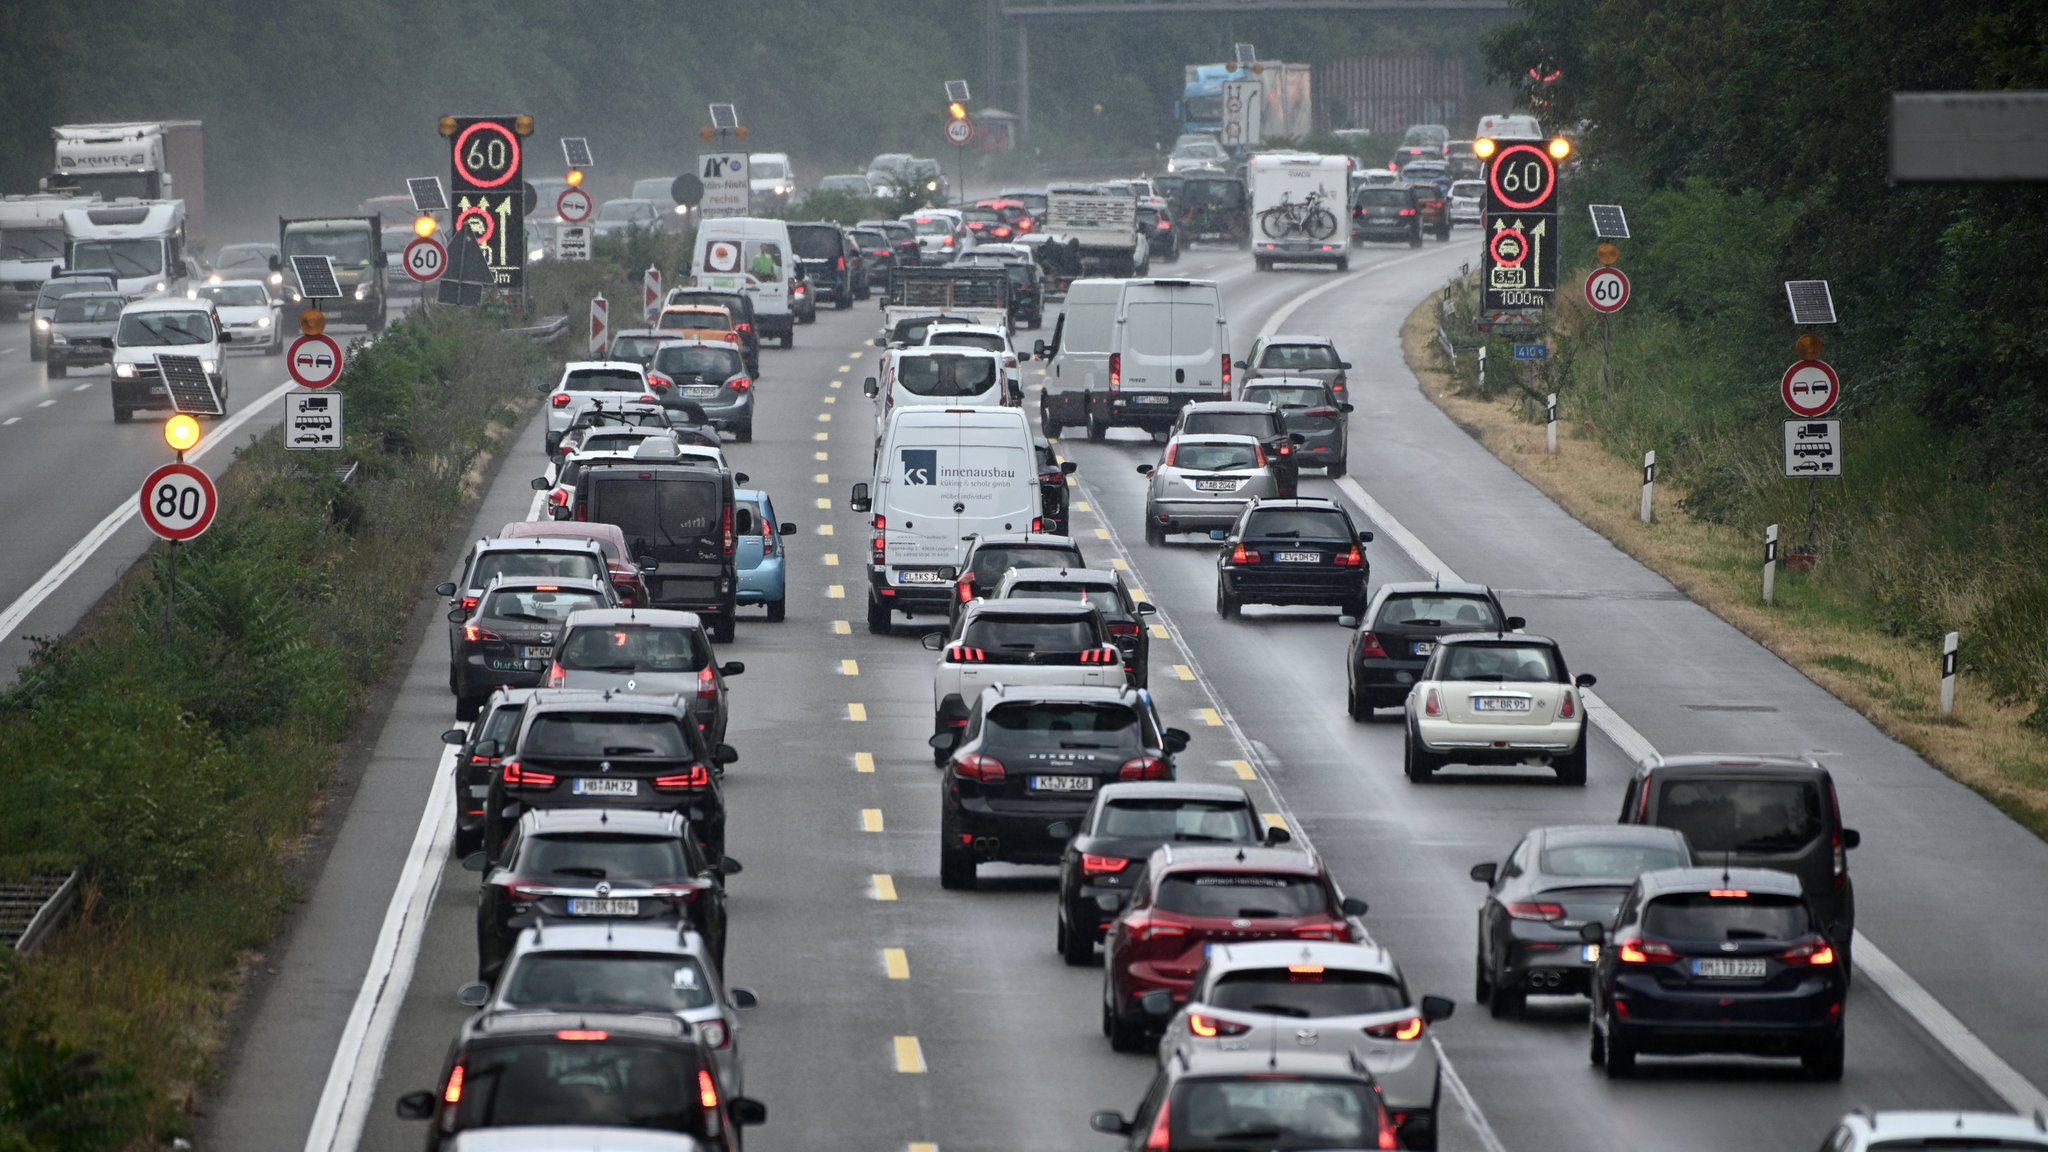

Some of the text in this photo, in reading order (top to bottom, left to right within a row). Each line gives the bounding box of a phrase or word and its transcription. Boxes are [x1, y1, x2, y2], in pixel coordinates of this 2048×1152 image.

[467, 139, 505, 169] 60
[1504, 161, 1540, 192] 60
[412, 248, 437, 268] 60
[1596, 280, 1620, 300] 60
[1518, 346, 1536, 356] 410
[940, 466, 1015, 478] innenausbau
[156, 484, 200, 520] 80
[1310, 553, 1318, 561] 57
[920, 572, 929, 580] KS
[1514, 700, 1526, 709] 95
[620, 782, 633, 792] 32
[1070, 777, 1088, 788] 168
